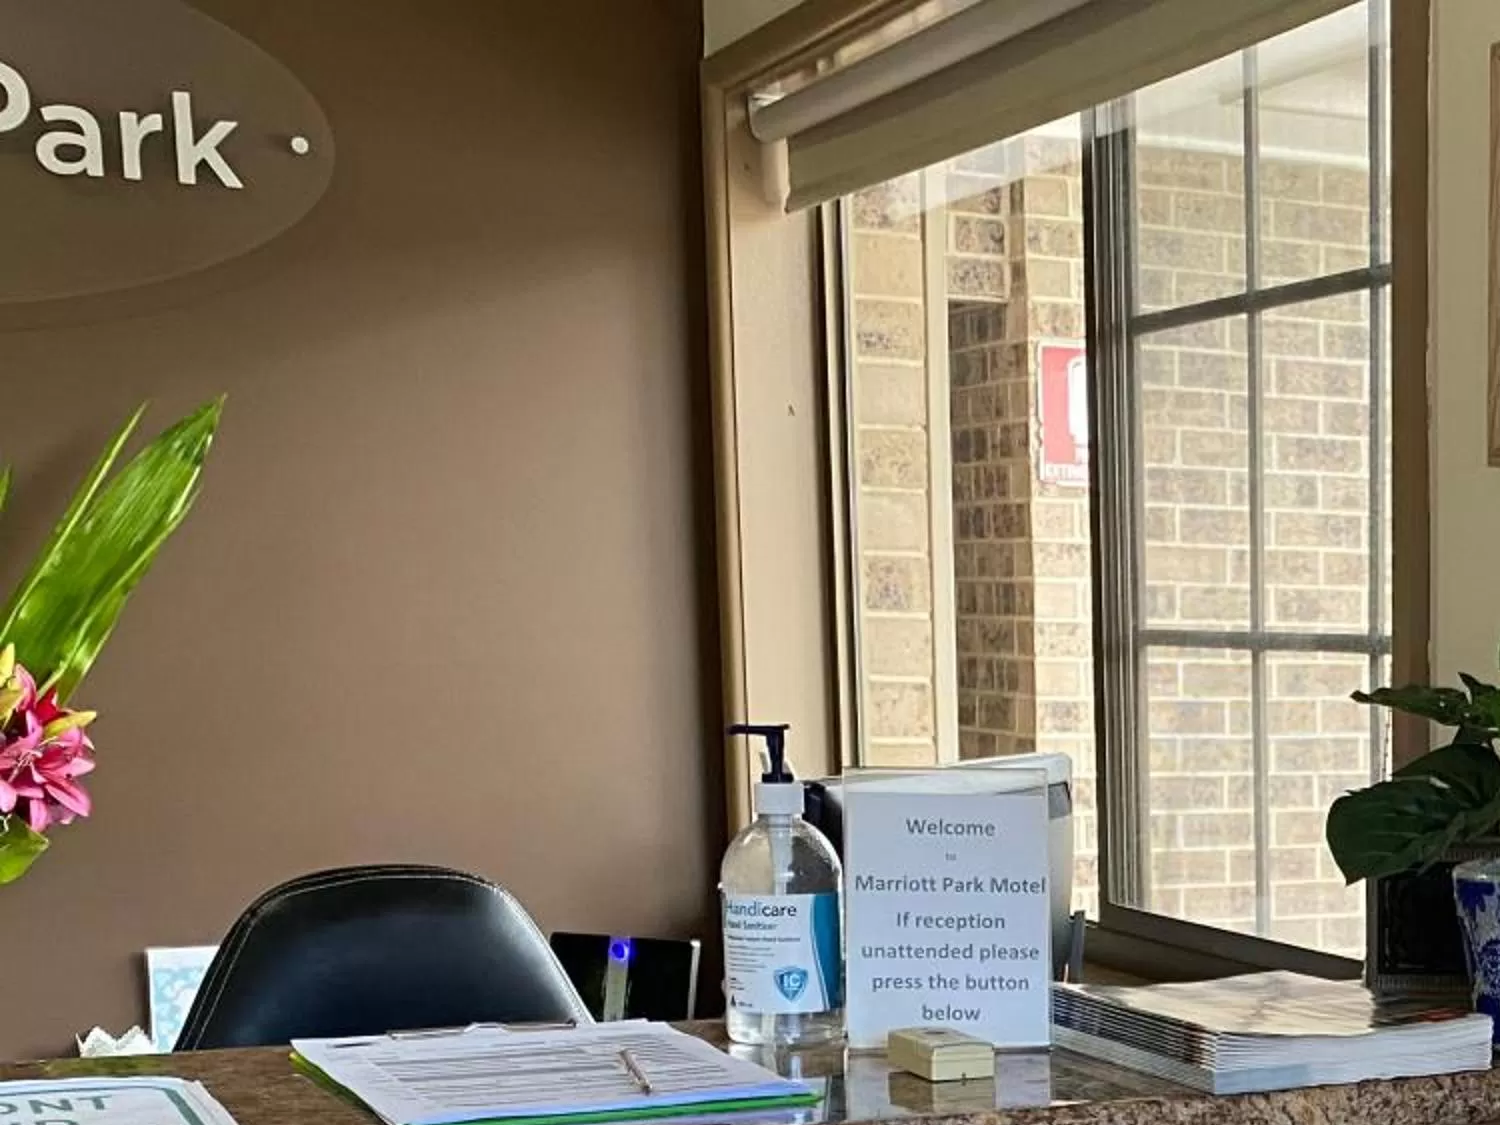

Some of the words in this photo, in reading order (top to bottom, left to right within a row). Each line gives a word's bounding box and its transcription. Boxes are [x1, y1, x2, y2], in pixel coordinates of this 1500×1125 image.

[906, 818, 997, 838] Welcome
[945, 851, 957, 862] to
[855, 875, 938, 895] Marriott
[942, 876, 984, 895] Park
[989, 877, 1047, 895] Motel
[726, 900, 798, 918] Handicare
[896, 911, 912, 929] If
[915, 913, 1006, 934] reception
[861, 943, 974, 962] unattended
[979, 943, 1040, 966] please
[872, 977, 923, 993] press
[928, 973, 960, 991] the
[964, 973, 1030, 992] button
[921, 1004, 981, 1022] below
